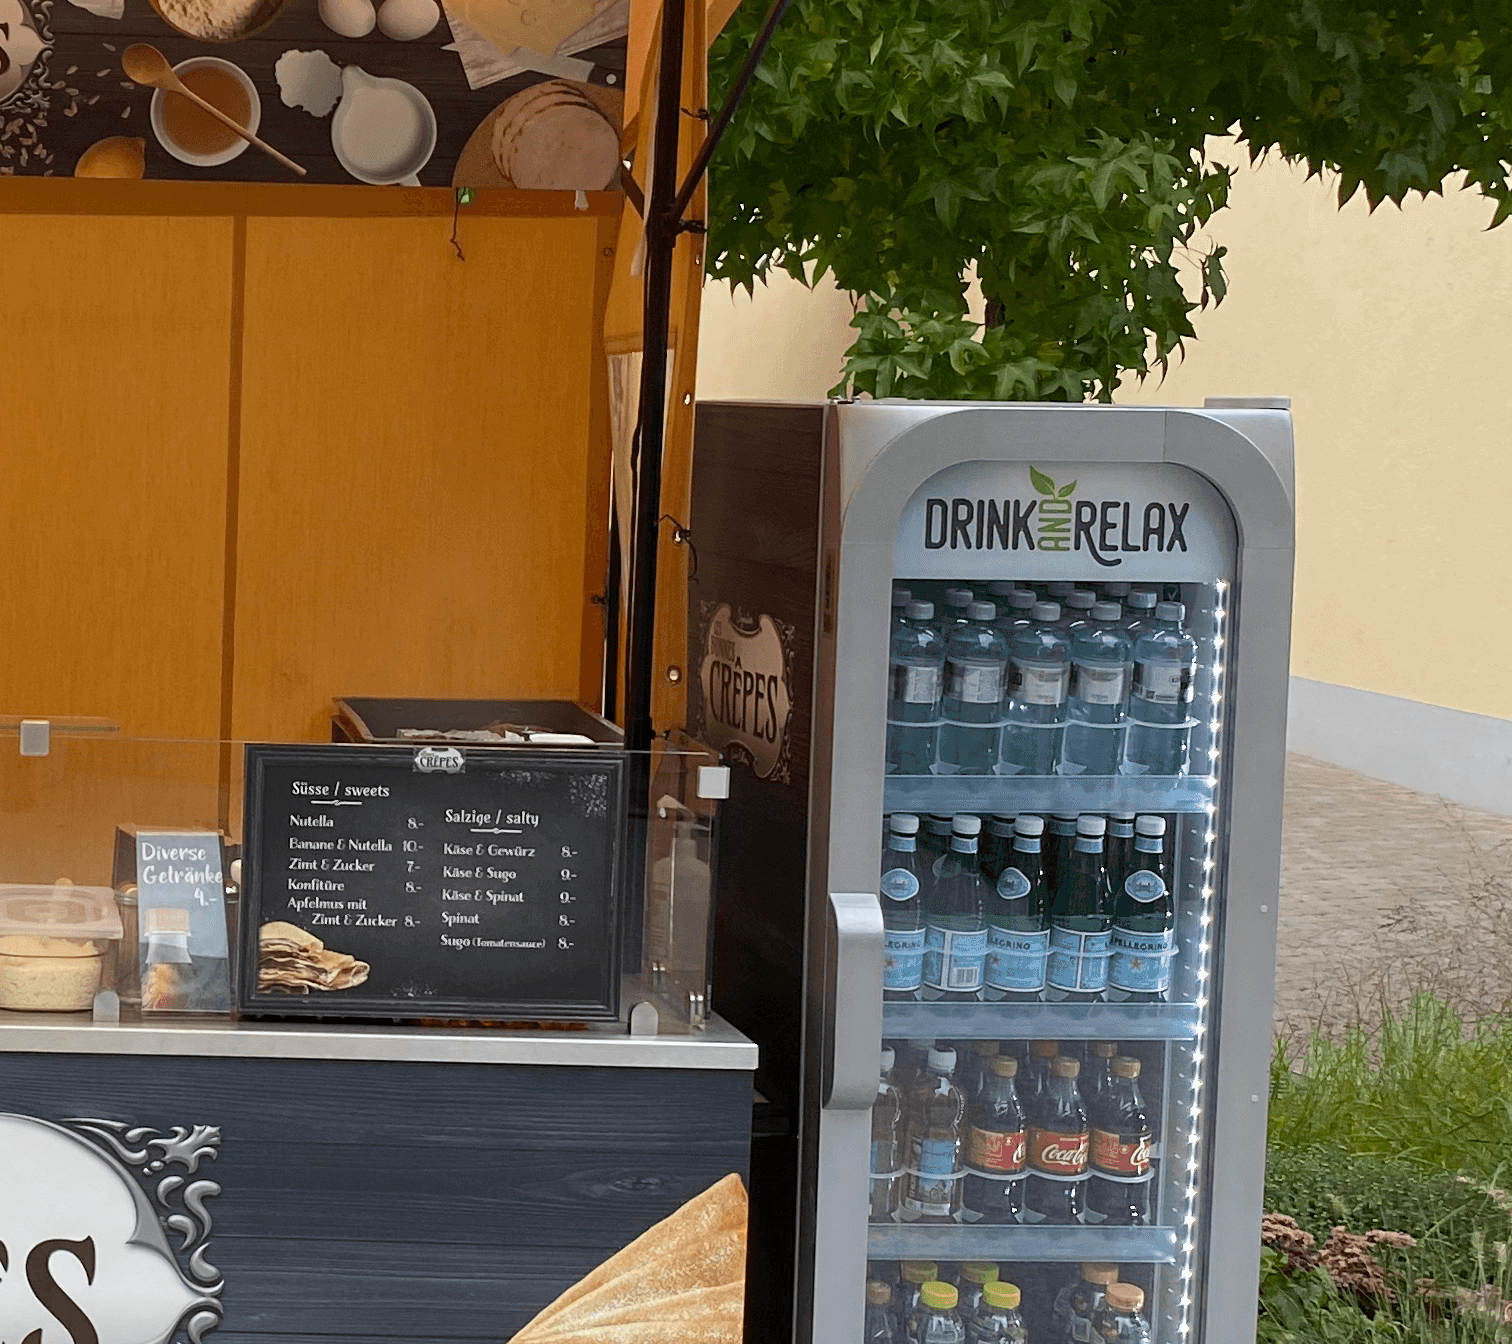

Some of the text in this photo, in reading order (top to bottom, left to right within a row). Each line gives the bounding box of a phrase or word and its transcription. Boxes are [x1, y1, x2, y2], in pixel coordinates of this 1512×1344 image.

[924, 498, 1190, 567] DRINK AND RELAX
[709, 657, 778, 744] CRÊPES
[291, 781, 330, 796] Süsse
[344, 784, 390, 797] sweets
[289, 814, 334, 828] Nutella
[445, 809, 491, 826] Salzige
[506, 811, 539, 827] salty
[142, 842, 207, 864] Diverse
[289, 838, 334, 852] Banane
[348, 839, 393, 852] Nutella
[443, 843, 474, 856] Käse
[487, 845, 536, 858] Gewürz
[288, 858, 318, 872] Zimt
[332, 858, 376, 872] Zucker
[142, 864, 225, 885] Getränke
[442, 866, 472, 879] Käse
[486, 867, 517, 882] Sugo
[287, 878, 345, 893] Konfitüre
[287, 897, 367, 912] Apfelmus mit
[442, 889, 472, 902] Käse
[485, 890, 524, 905] Spinat
[311, 913, 341, 927] Zimt
[355, 914, 398, 928] Zucker
[441, 911, 480, 926] Spinat
[440, 934, 471, 951] Sugo
[472, 937, 546, 950] (Tomatensauce)
